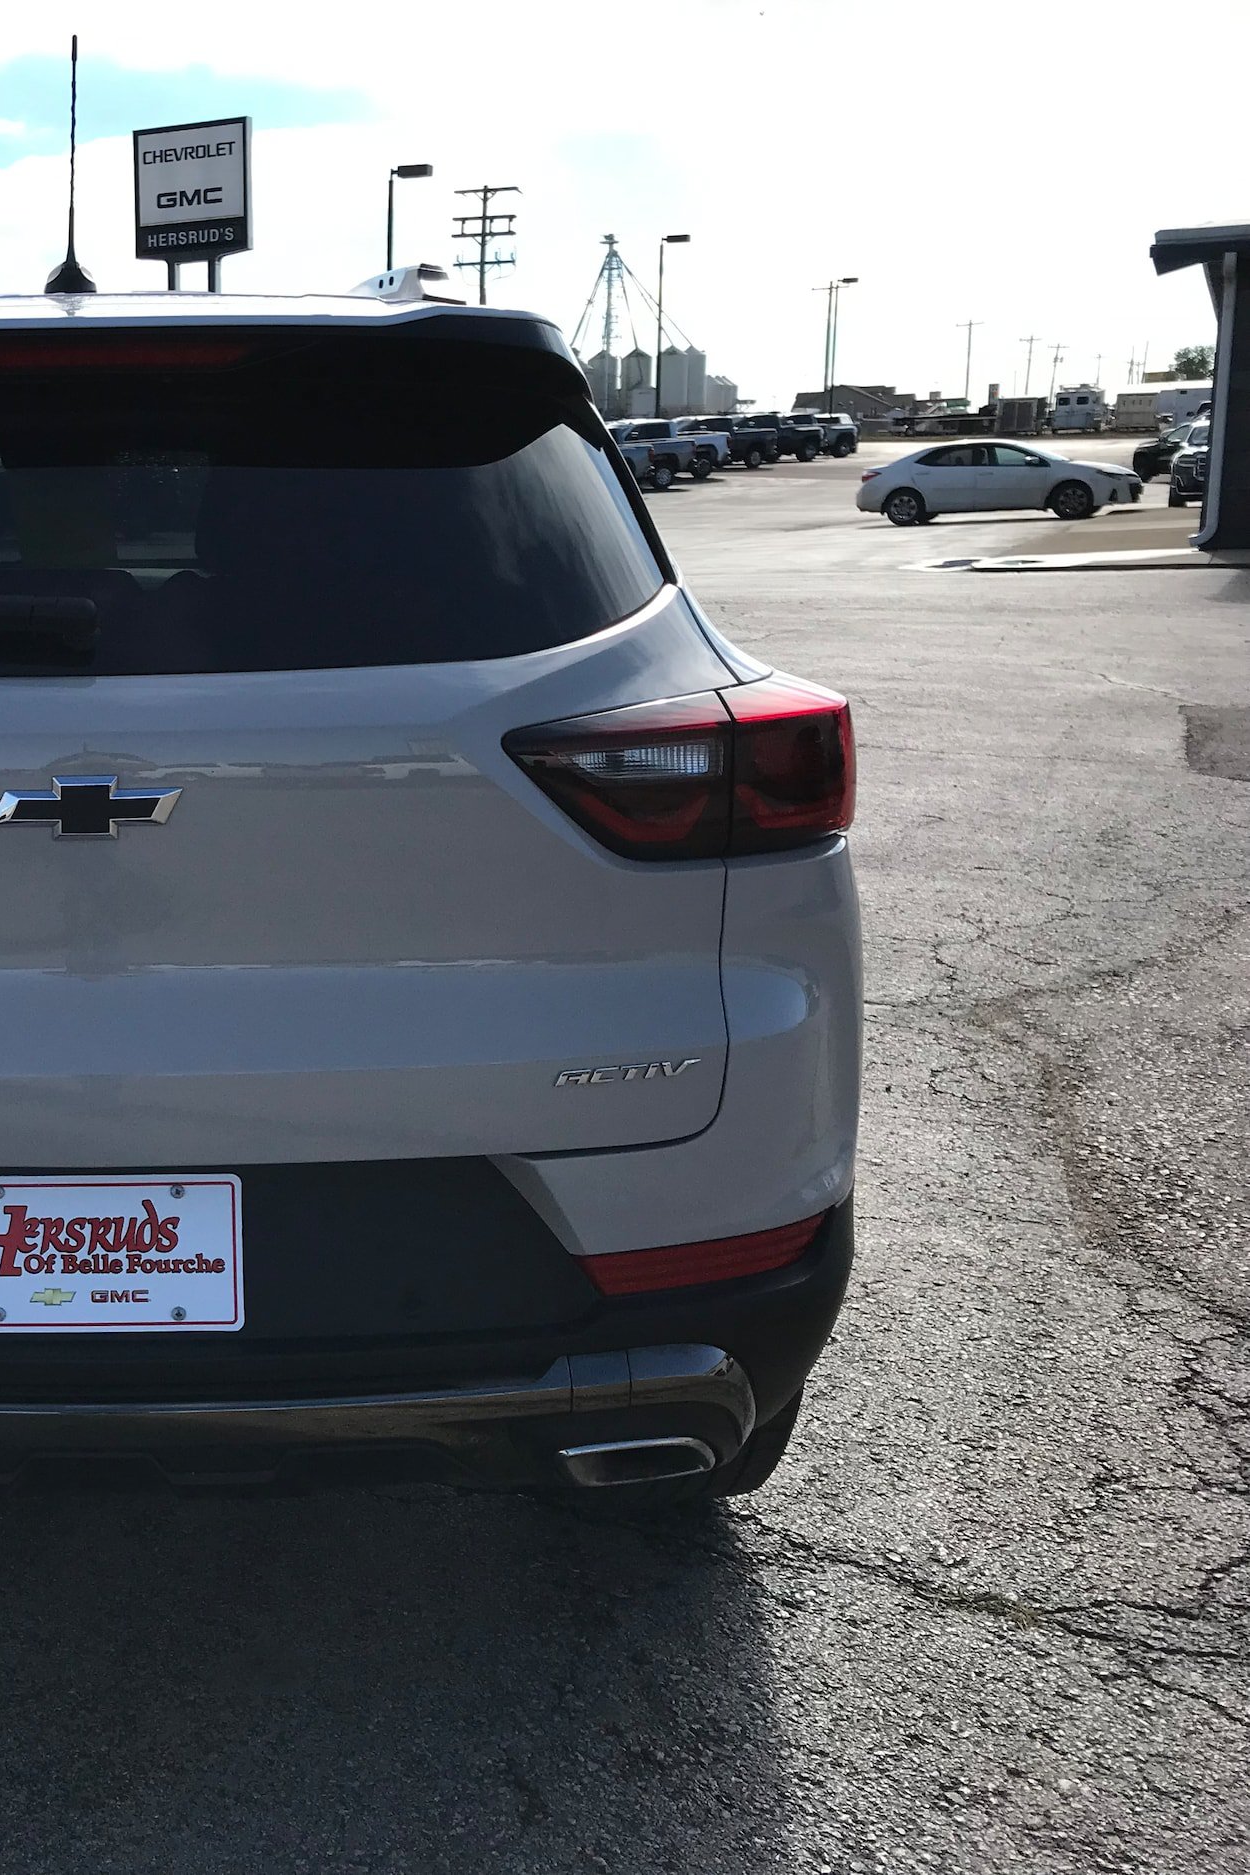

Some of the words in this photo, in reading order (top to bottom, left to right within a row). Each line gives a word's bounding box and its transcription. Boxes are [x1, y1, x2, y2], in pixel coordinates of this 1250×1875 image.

[143, 141, 236, 165] CHEVROLET
[157, 187, 223, 209] GMC
[148, 227, 235, 248] HERSRUD'S
[554, 1057, 702, 1088] ACTIV
[23, 1253, 56, 1274] Of
[61, 1254, 123, 1274] Belle
[126, 1253, 225, 1274] Fourche
[91, 1289, 151, 1303] GMC
